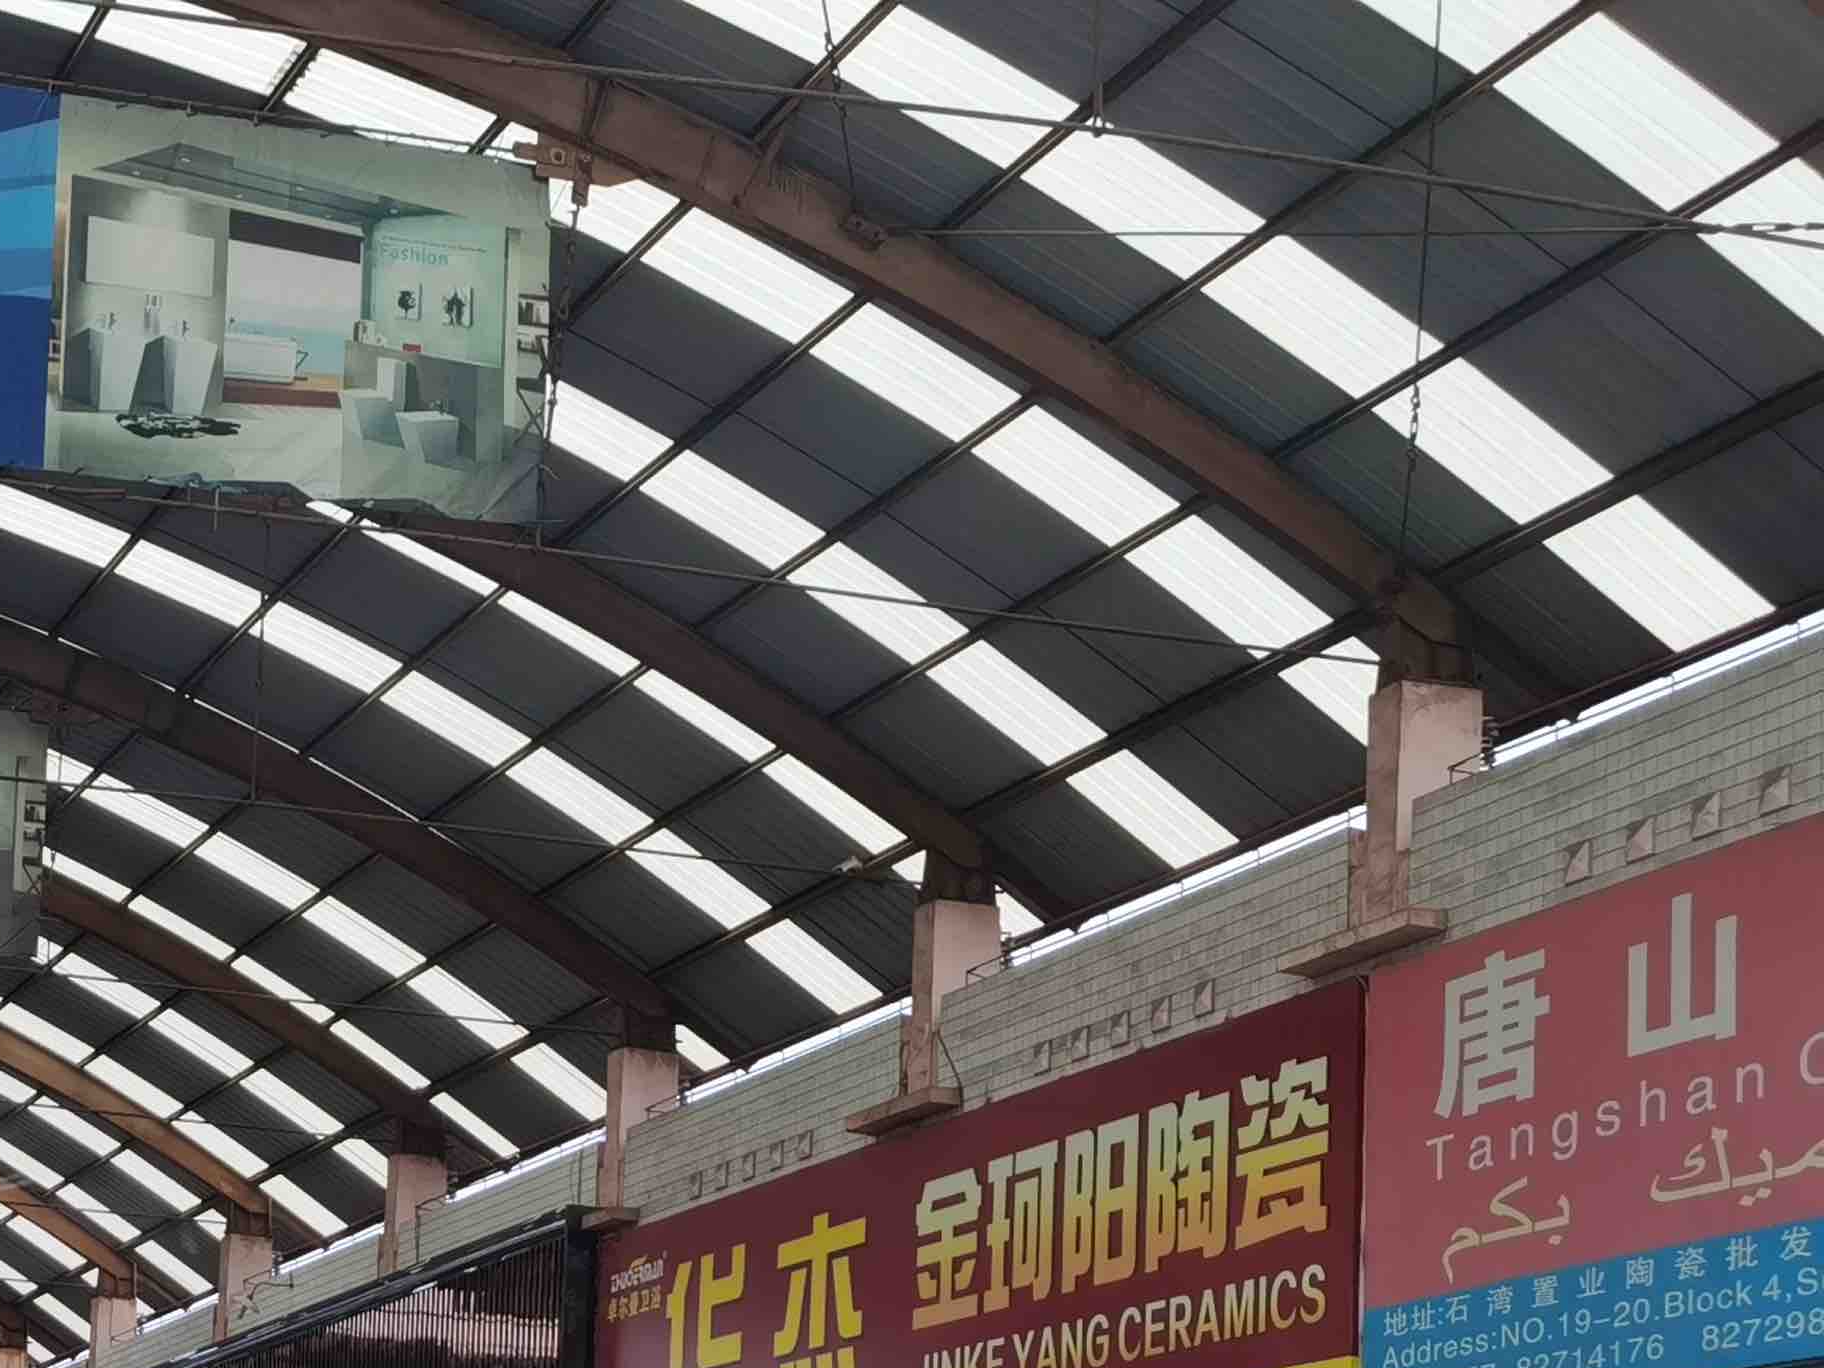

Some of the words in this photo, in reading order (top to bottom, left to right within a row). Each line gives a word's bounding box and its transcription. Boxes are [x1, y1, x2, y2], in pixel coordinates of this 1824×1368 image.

[1433, 892, 1739, 1120] 唐山
[1425, 1062, 1765, 1181] Tangshan
[911, 1055, 1330, 1332] 金珂阳陶瓷
[1117, 1262, 1327, 1365] CERAMICS
[1761, 1266, 1824, 1302] 4,S
